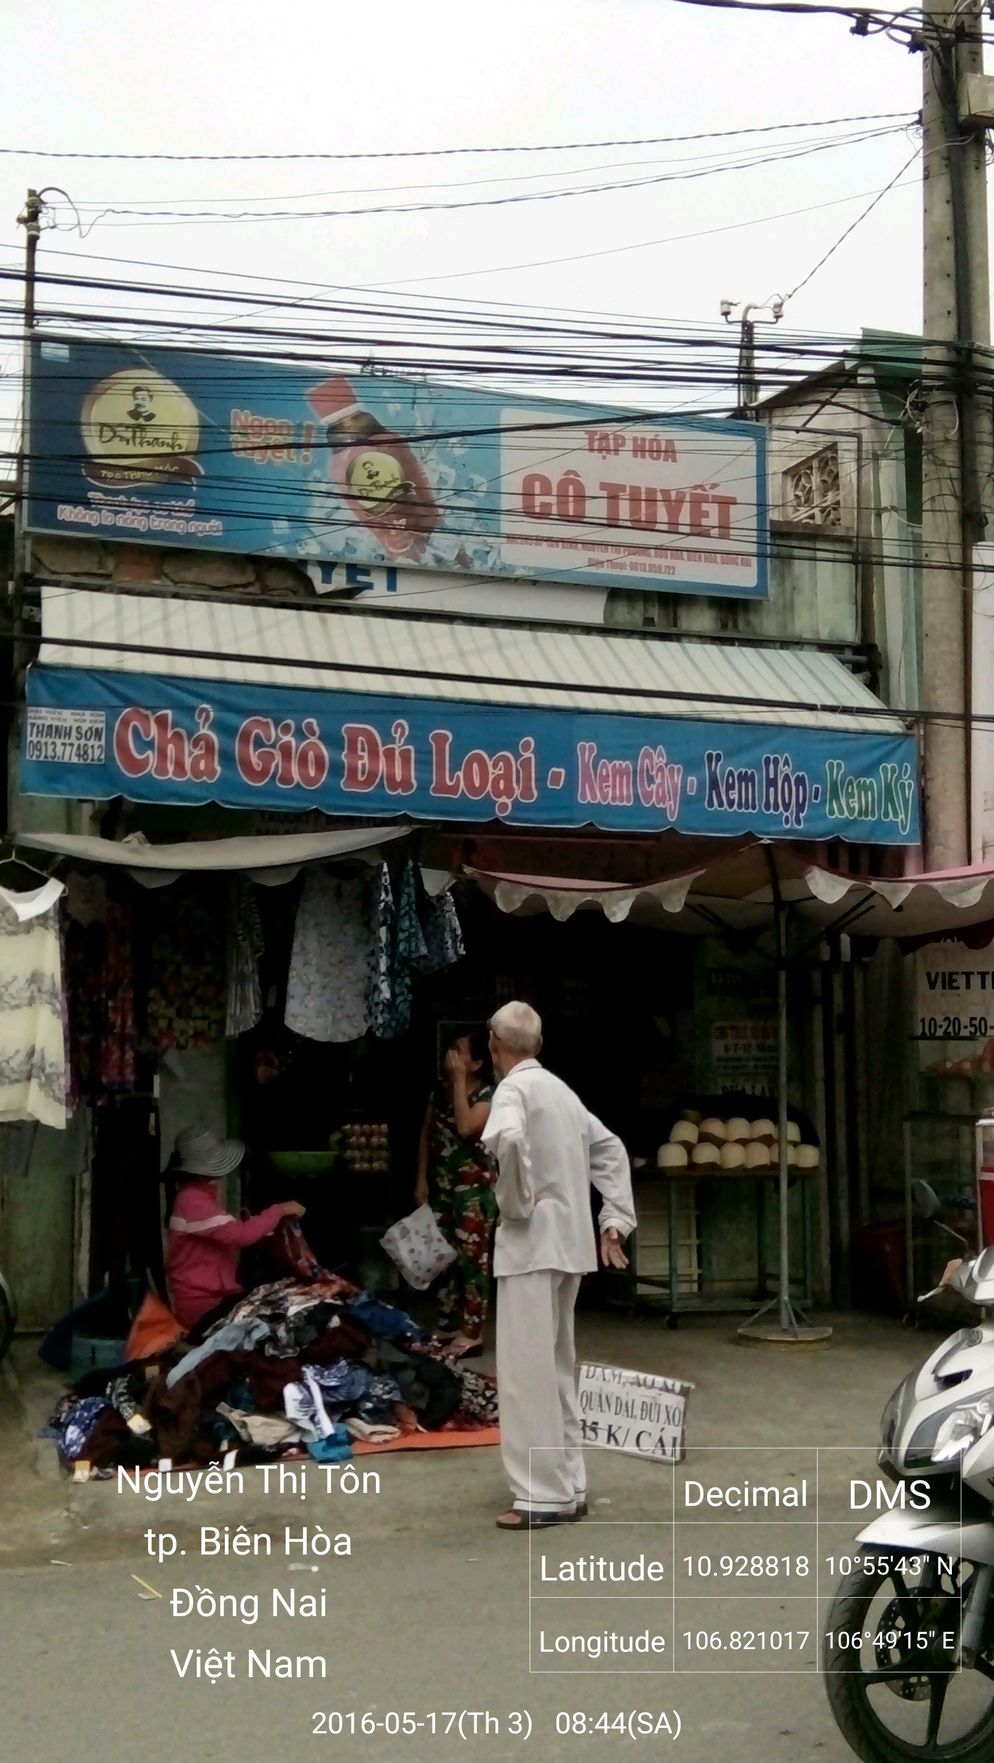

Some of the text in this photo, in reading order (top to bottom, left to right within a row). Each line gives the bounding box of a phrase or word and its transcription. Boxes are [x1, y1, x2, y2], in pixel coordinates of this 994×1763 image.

[231, 409, 294, 440] Ngon
[585, 430, 678, 463] TẠP HÓA
[57, 504, 100, 526] Không
[101, 509, 115, 526] lo
[116, 512, 149, 532] nóng
[150, 515, 187, 535] trong
[521, 469, 739, 540] CÔ TUYẾT
[29, 722, 104, 742] THANH SƠN
[28, 740, 105, 763] 0913.774812
[113, 704, 222, 785] Chả
[235, 716, 330, 790] Giò
[340, 718, 416, 796] Đủ
[429, 729, 536, 817] Loại
[547, 767, 566, 790] -
[577, 741, 634, 807] Kem
[637, 744, 683, 822] Cây
[704, 750, 758, 813] Kem
[761, 754, 810, 828] Hộp
[825, 760, 878, 820] Kem
[880, 763, 914, 835] Ký
[635, 1427, 679, 1458] CÁI
